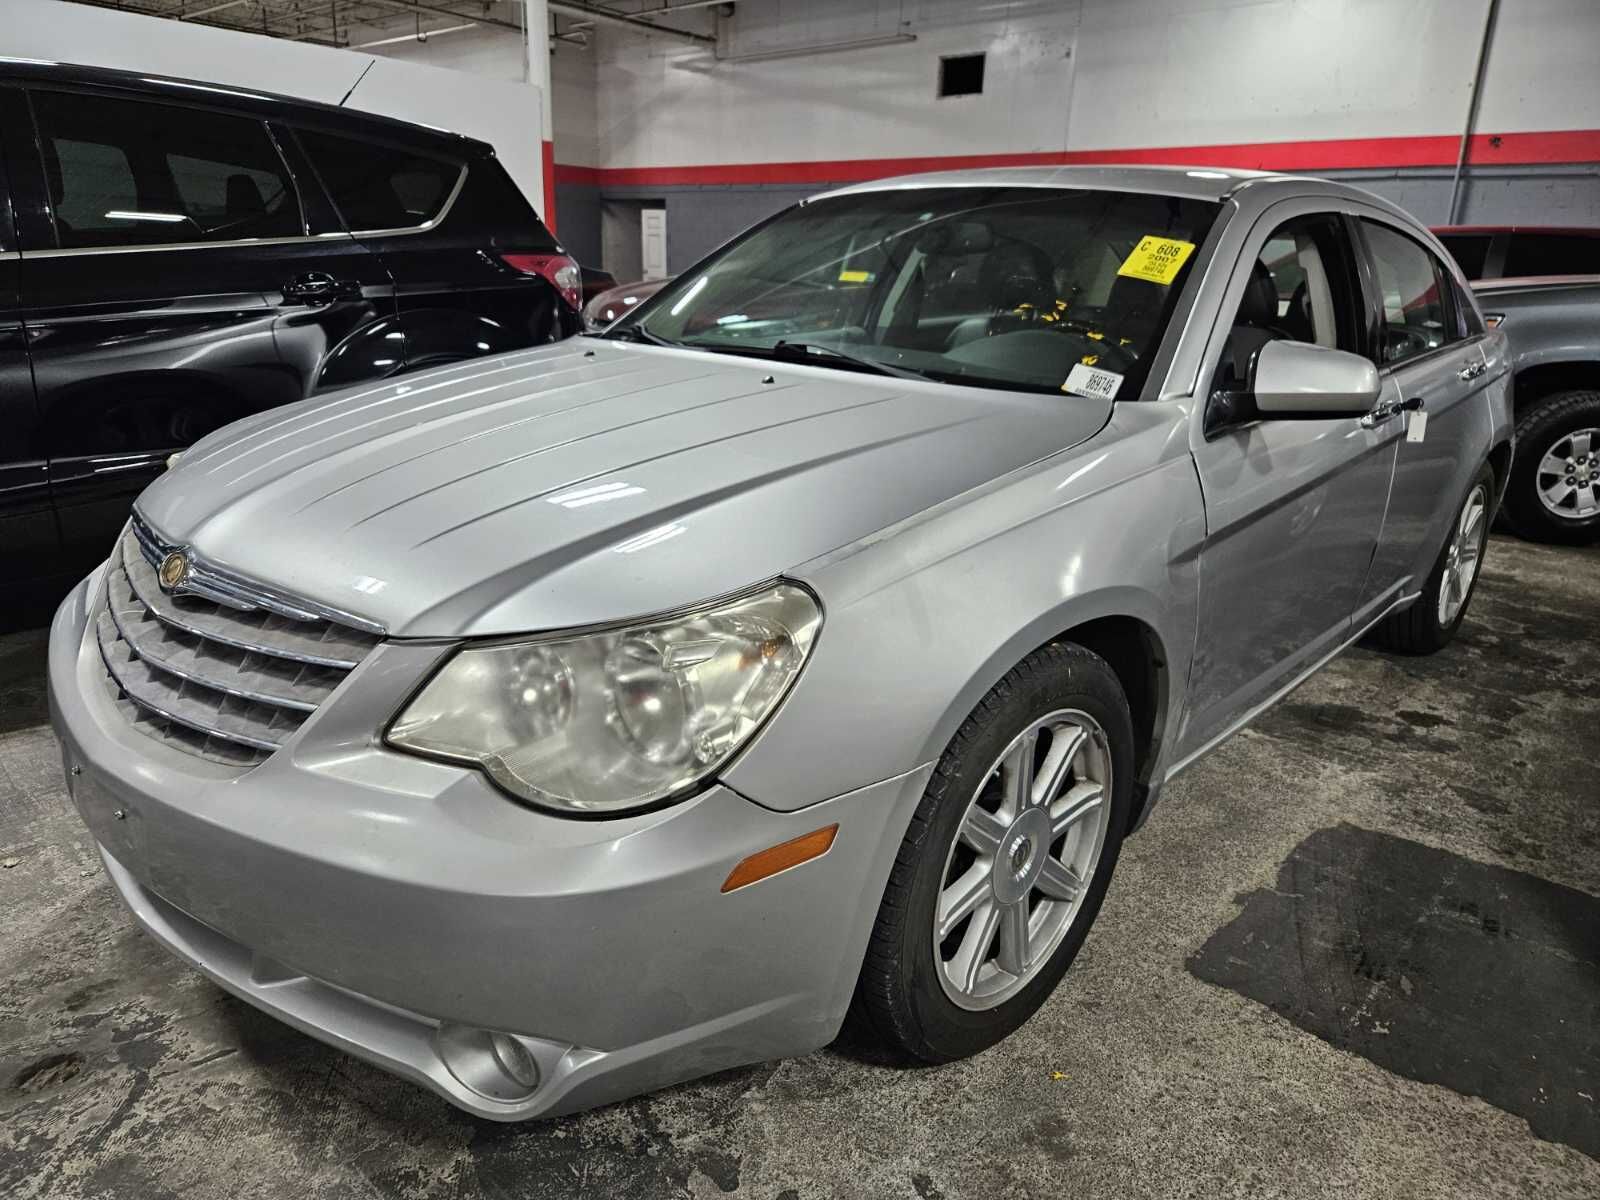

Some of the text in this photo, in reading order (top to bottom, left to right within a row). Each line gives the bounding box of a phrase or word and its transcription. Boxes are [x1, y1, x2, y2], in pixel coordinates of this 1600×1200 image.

[1140, 241, 1181, 257] C 608
[1148, 253, 1177, 264] 2007
